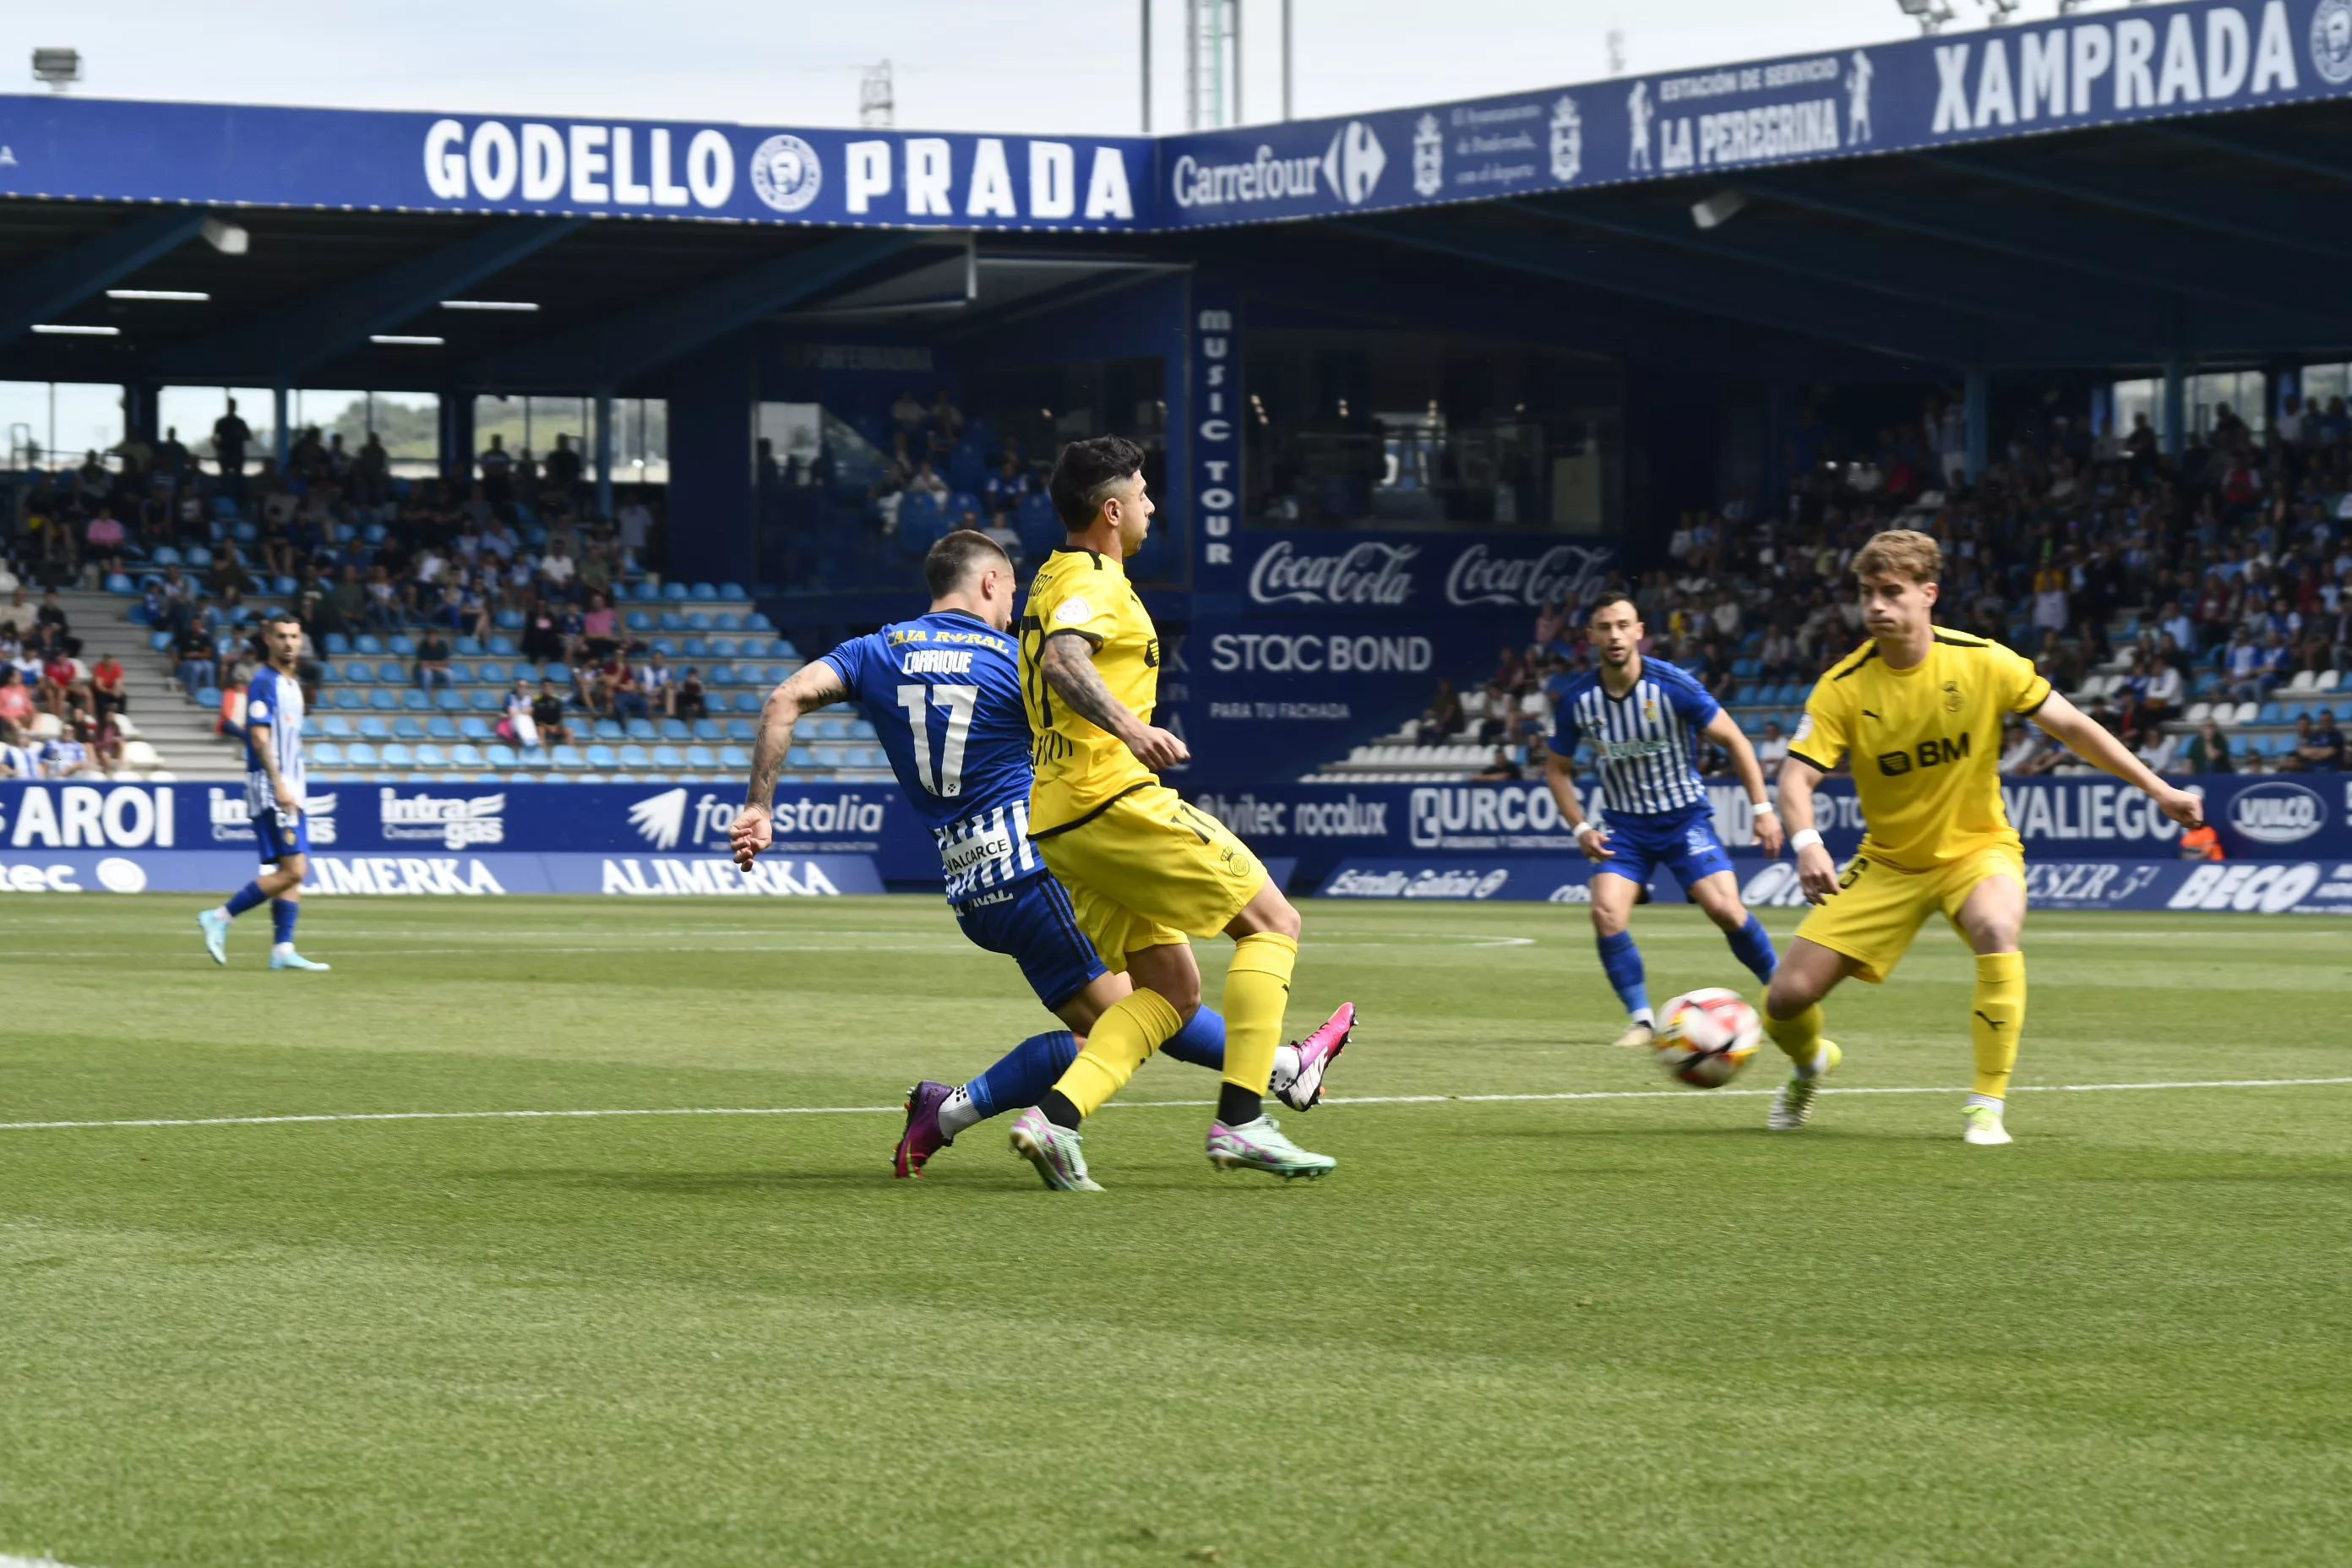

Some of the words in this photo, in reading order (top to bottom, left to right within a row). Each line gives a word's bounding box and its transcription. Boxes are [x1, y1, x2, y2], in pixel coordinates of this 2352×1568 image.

[1740, 68, 1761, 91] DE
[1765, 57, 1838, 89] SERVICIO
[1931, 0, 2300, 133] XAMPRADA
[1660, 117, 1694, 169] LA
[1699, 98, 1839, 165] PEREGRINA
[423, 118, 735, 209] GODELLO
[846, 138, 1134, 220] PRADA
[1173, 144, 1323, 208] Carrefour
[1200, 460, 1234, 564] TOUR
[1210, 703, 1252, 718] PARA
[1255, 704, 1277, 718] TU
[1279, 703, 1350, 718] FACHADA
[897, 684, 979, 797] 17
[1916, 732, 1970, 767] BM
[11, 786, 174, 847] AROI
[692, 794, 884, 844] fostalia
[1294, 793, 1388, 836] rocalux
[2240, 796, 2315, 827] VULCO
[259, 857, 506, 894] IMERKA
[602, 858, 841, 896] ALIMERKA
[944, 838, 1009, 872] VALCARCE
[2166, 863, 2321, 915] BECO
